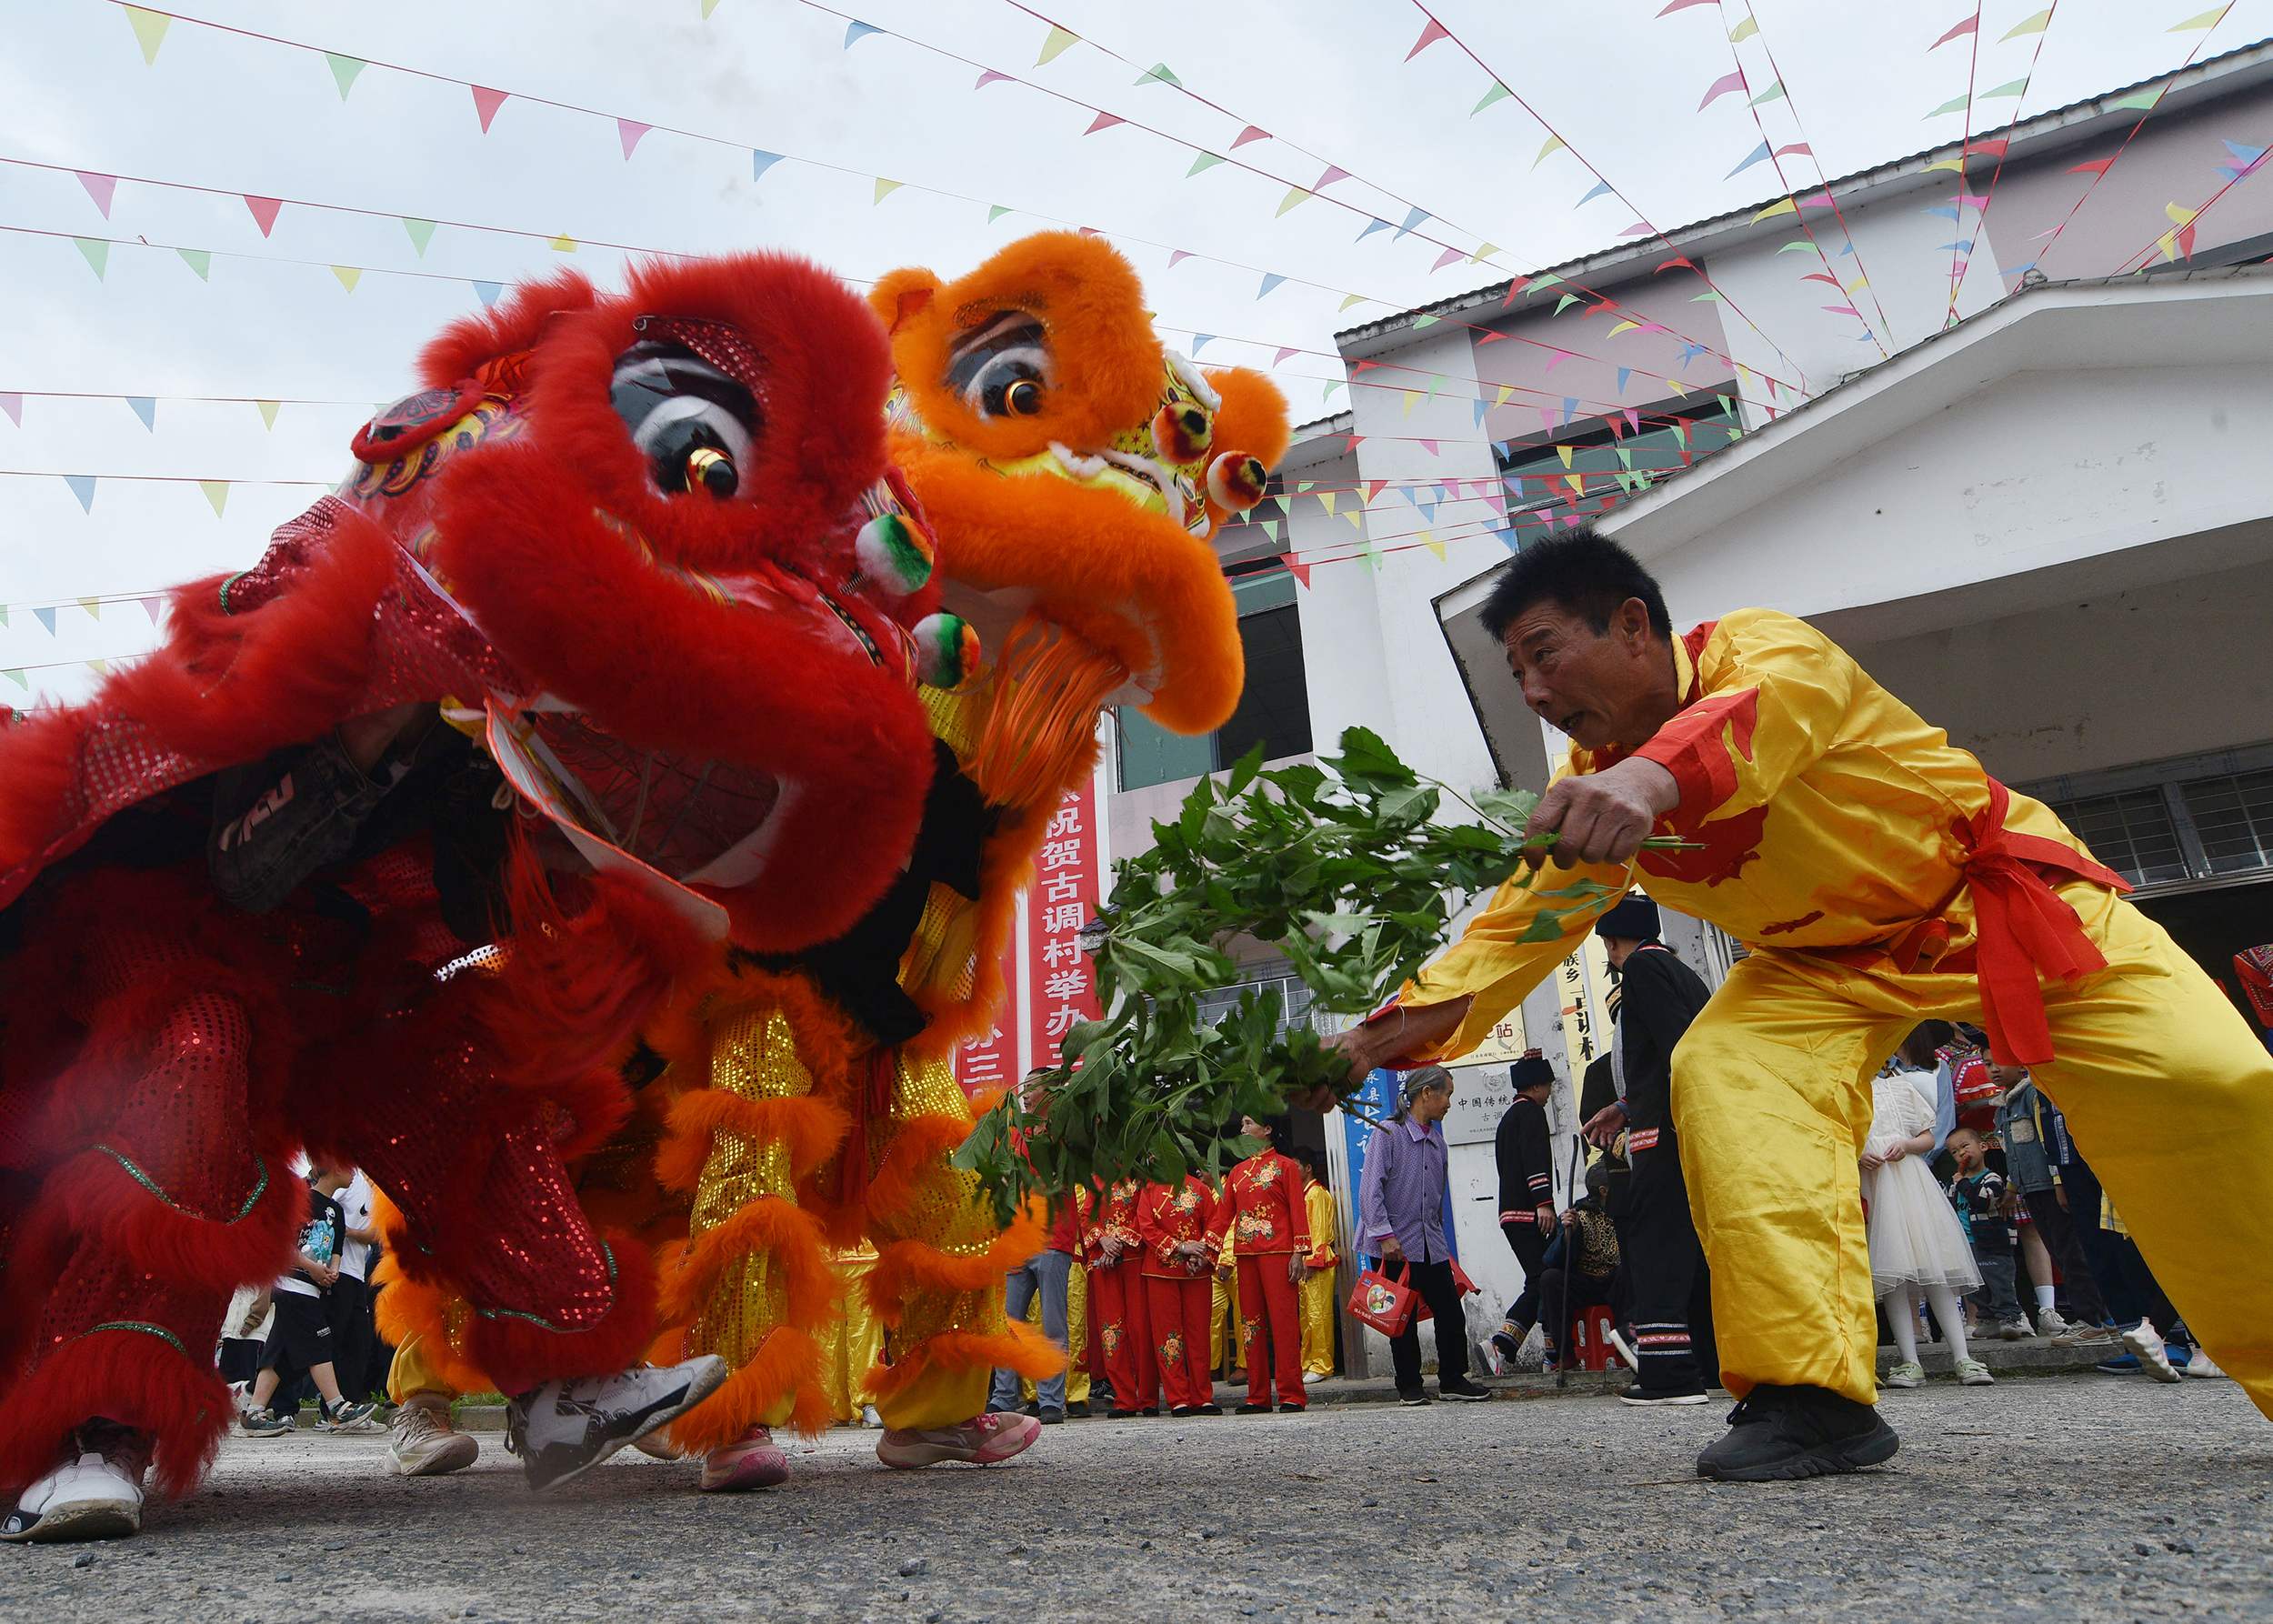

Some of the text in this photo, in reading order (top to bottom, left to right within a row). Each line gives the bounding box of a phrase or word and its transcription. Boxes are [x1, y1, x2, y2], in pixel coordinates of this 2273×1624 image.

[1041, 791, 1088, 1070] 祝贺古调村举办三
[1457, 1094, 1517, 1110] 中国传统
